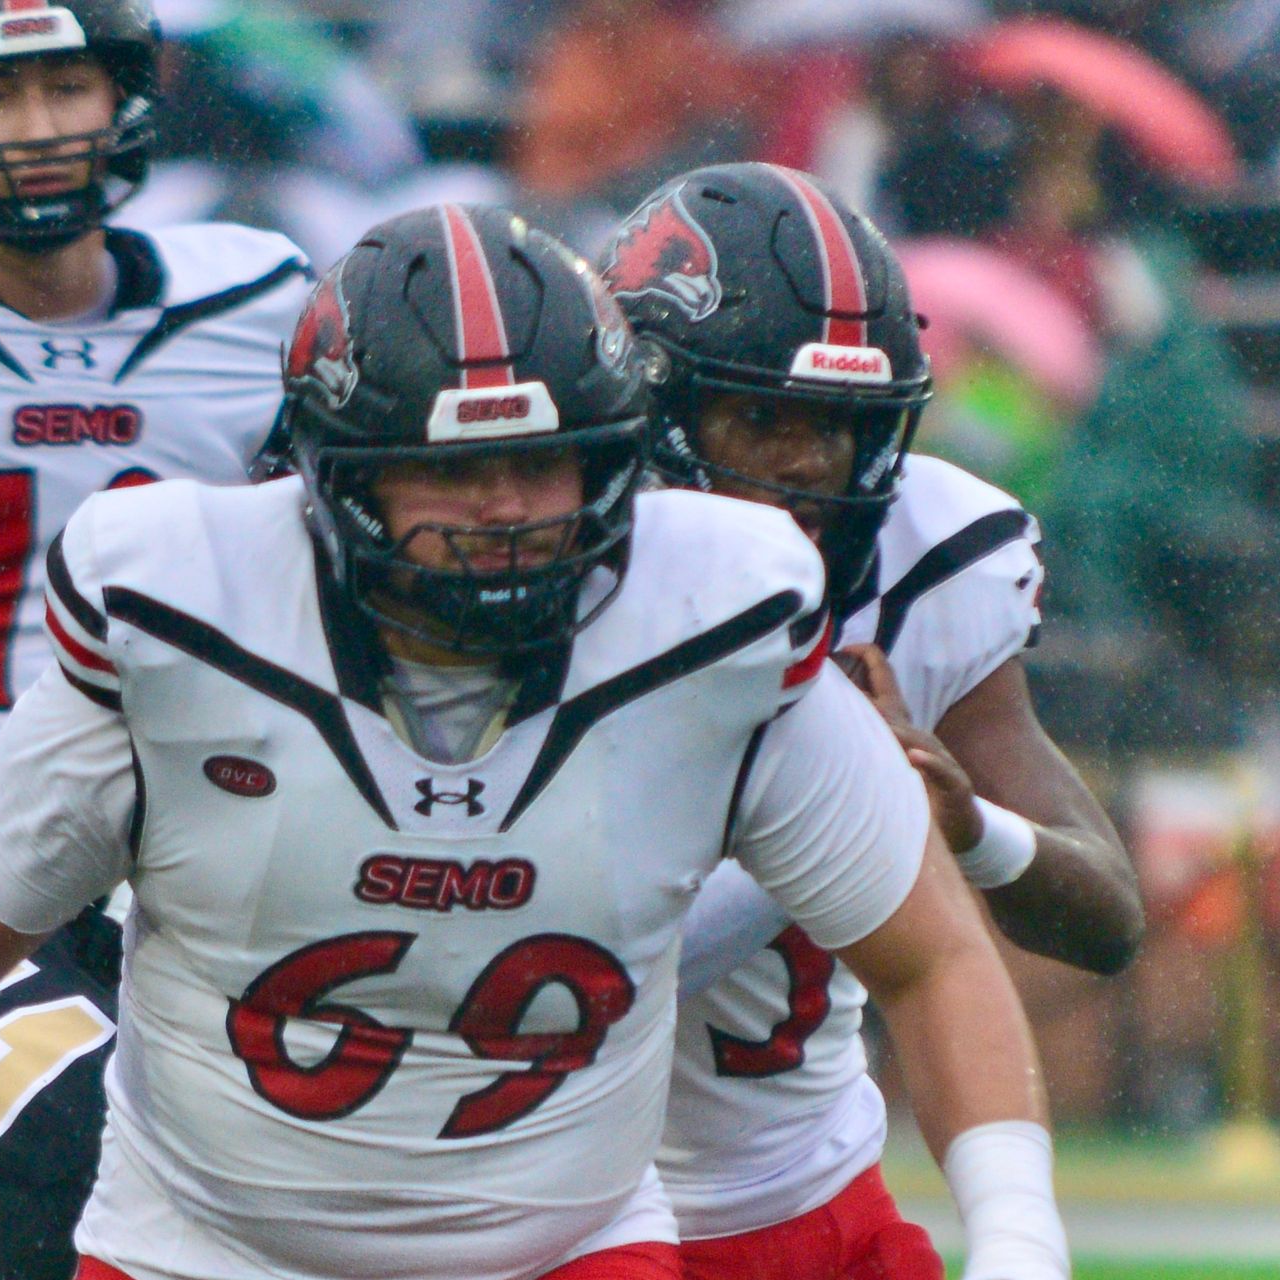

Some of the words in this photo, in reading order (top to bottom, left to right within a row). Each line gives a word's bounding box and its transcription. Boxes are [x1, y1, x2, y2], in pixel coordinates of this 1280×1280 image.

[811, 351, 883, 374] Riddell
[13, 403, 142, 446] SEMO
[354, 852, 537, 912] SEMO
[224, 929, 637, 1139] 69
